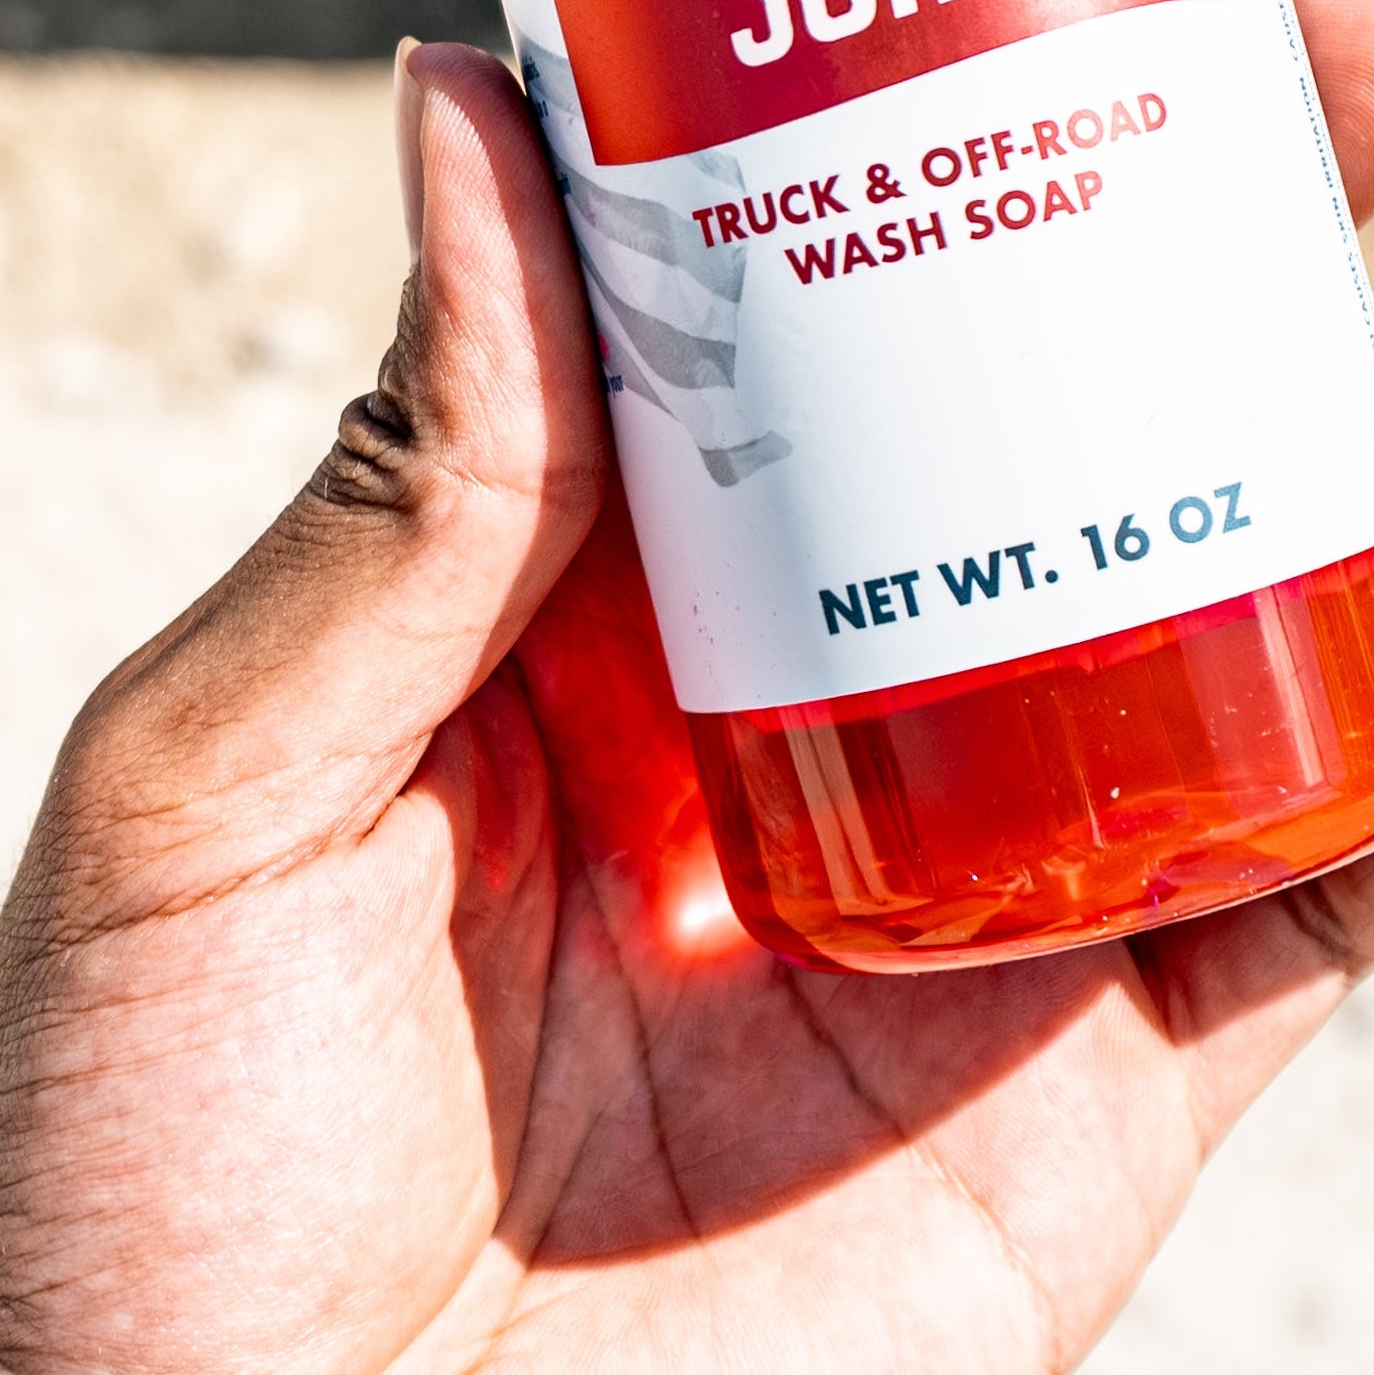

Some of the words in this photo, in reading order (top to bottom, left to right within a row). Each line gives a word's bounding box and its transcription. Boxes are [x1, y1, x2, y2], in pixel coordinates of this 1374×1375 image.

[692, 175, 850, 249] TRUCK
[866, 162, 906, 205] &
[921, 92, 1168, 182] OFF-ROAD
[785, 208, 947, 286] WASH
[964, 169, 1104, 241] SOAP
[819, 570, 921, 637] NET
[937, 541, 1059, 609] WT.
[1081, 513, 1149, 573] 16
[1169, 481, 1252, 546] OZ
